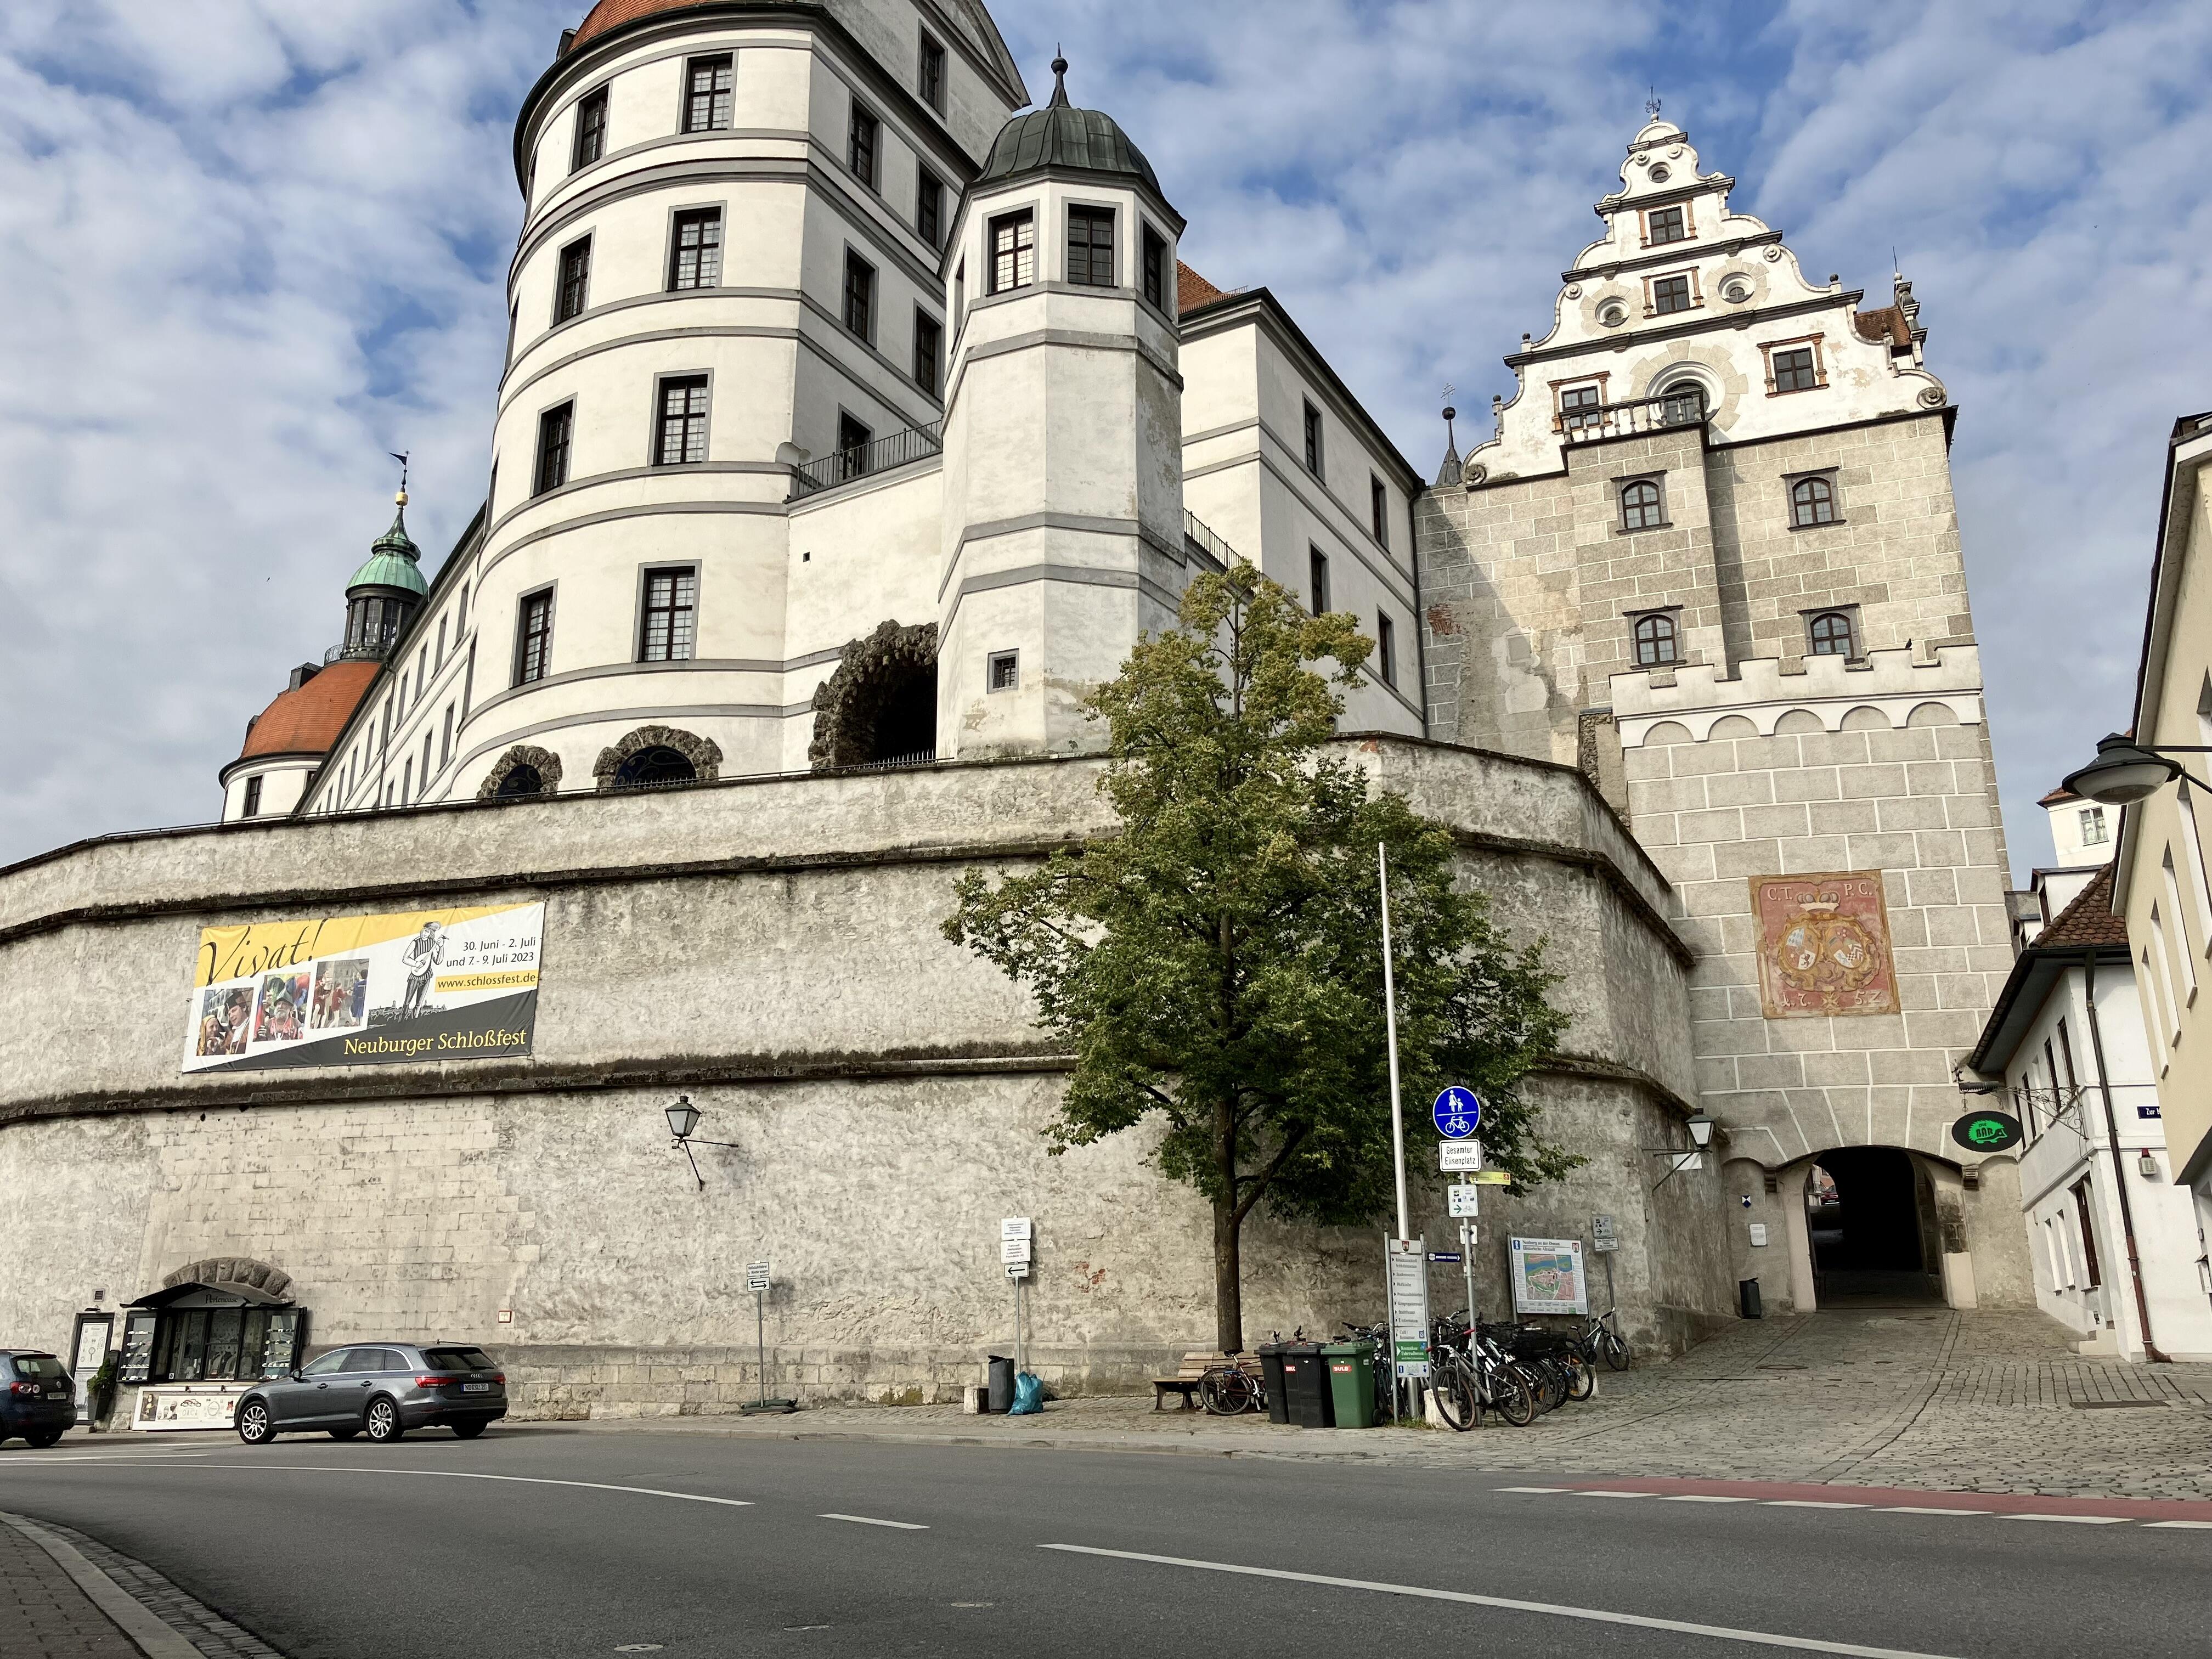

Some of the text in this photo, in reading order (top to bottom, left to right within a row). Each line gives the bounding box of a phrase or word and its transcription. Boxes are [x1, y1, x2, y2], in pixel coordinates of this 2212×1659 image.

[463, 941, 477, 951] 30.
[480, 939, 499, 951] Juni
[508, 938, 517, 948] 2.
[520, 936, 536, 949] Juli
[199, 918, 329, 986] Vivat!
[447, 956, 465, 967] und
[482, 955, 489, 964] 9.
[492, 953, 508, 966] Juli
[511, 952, 534, 962] 2023
[438, 972, 536, 988] www.schlossfest.de
[344, 1029, 527, 1057] Neuburger Schloßfest
[1976, 1127, 1994, 1138] BAR
[1446, 1146, 1472, 1154] Gesamter
[1445, 1156, 1476, 1166] Elisenplatz
